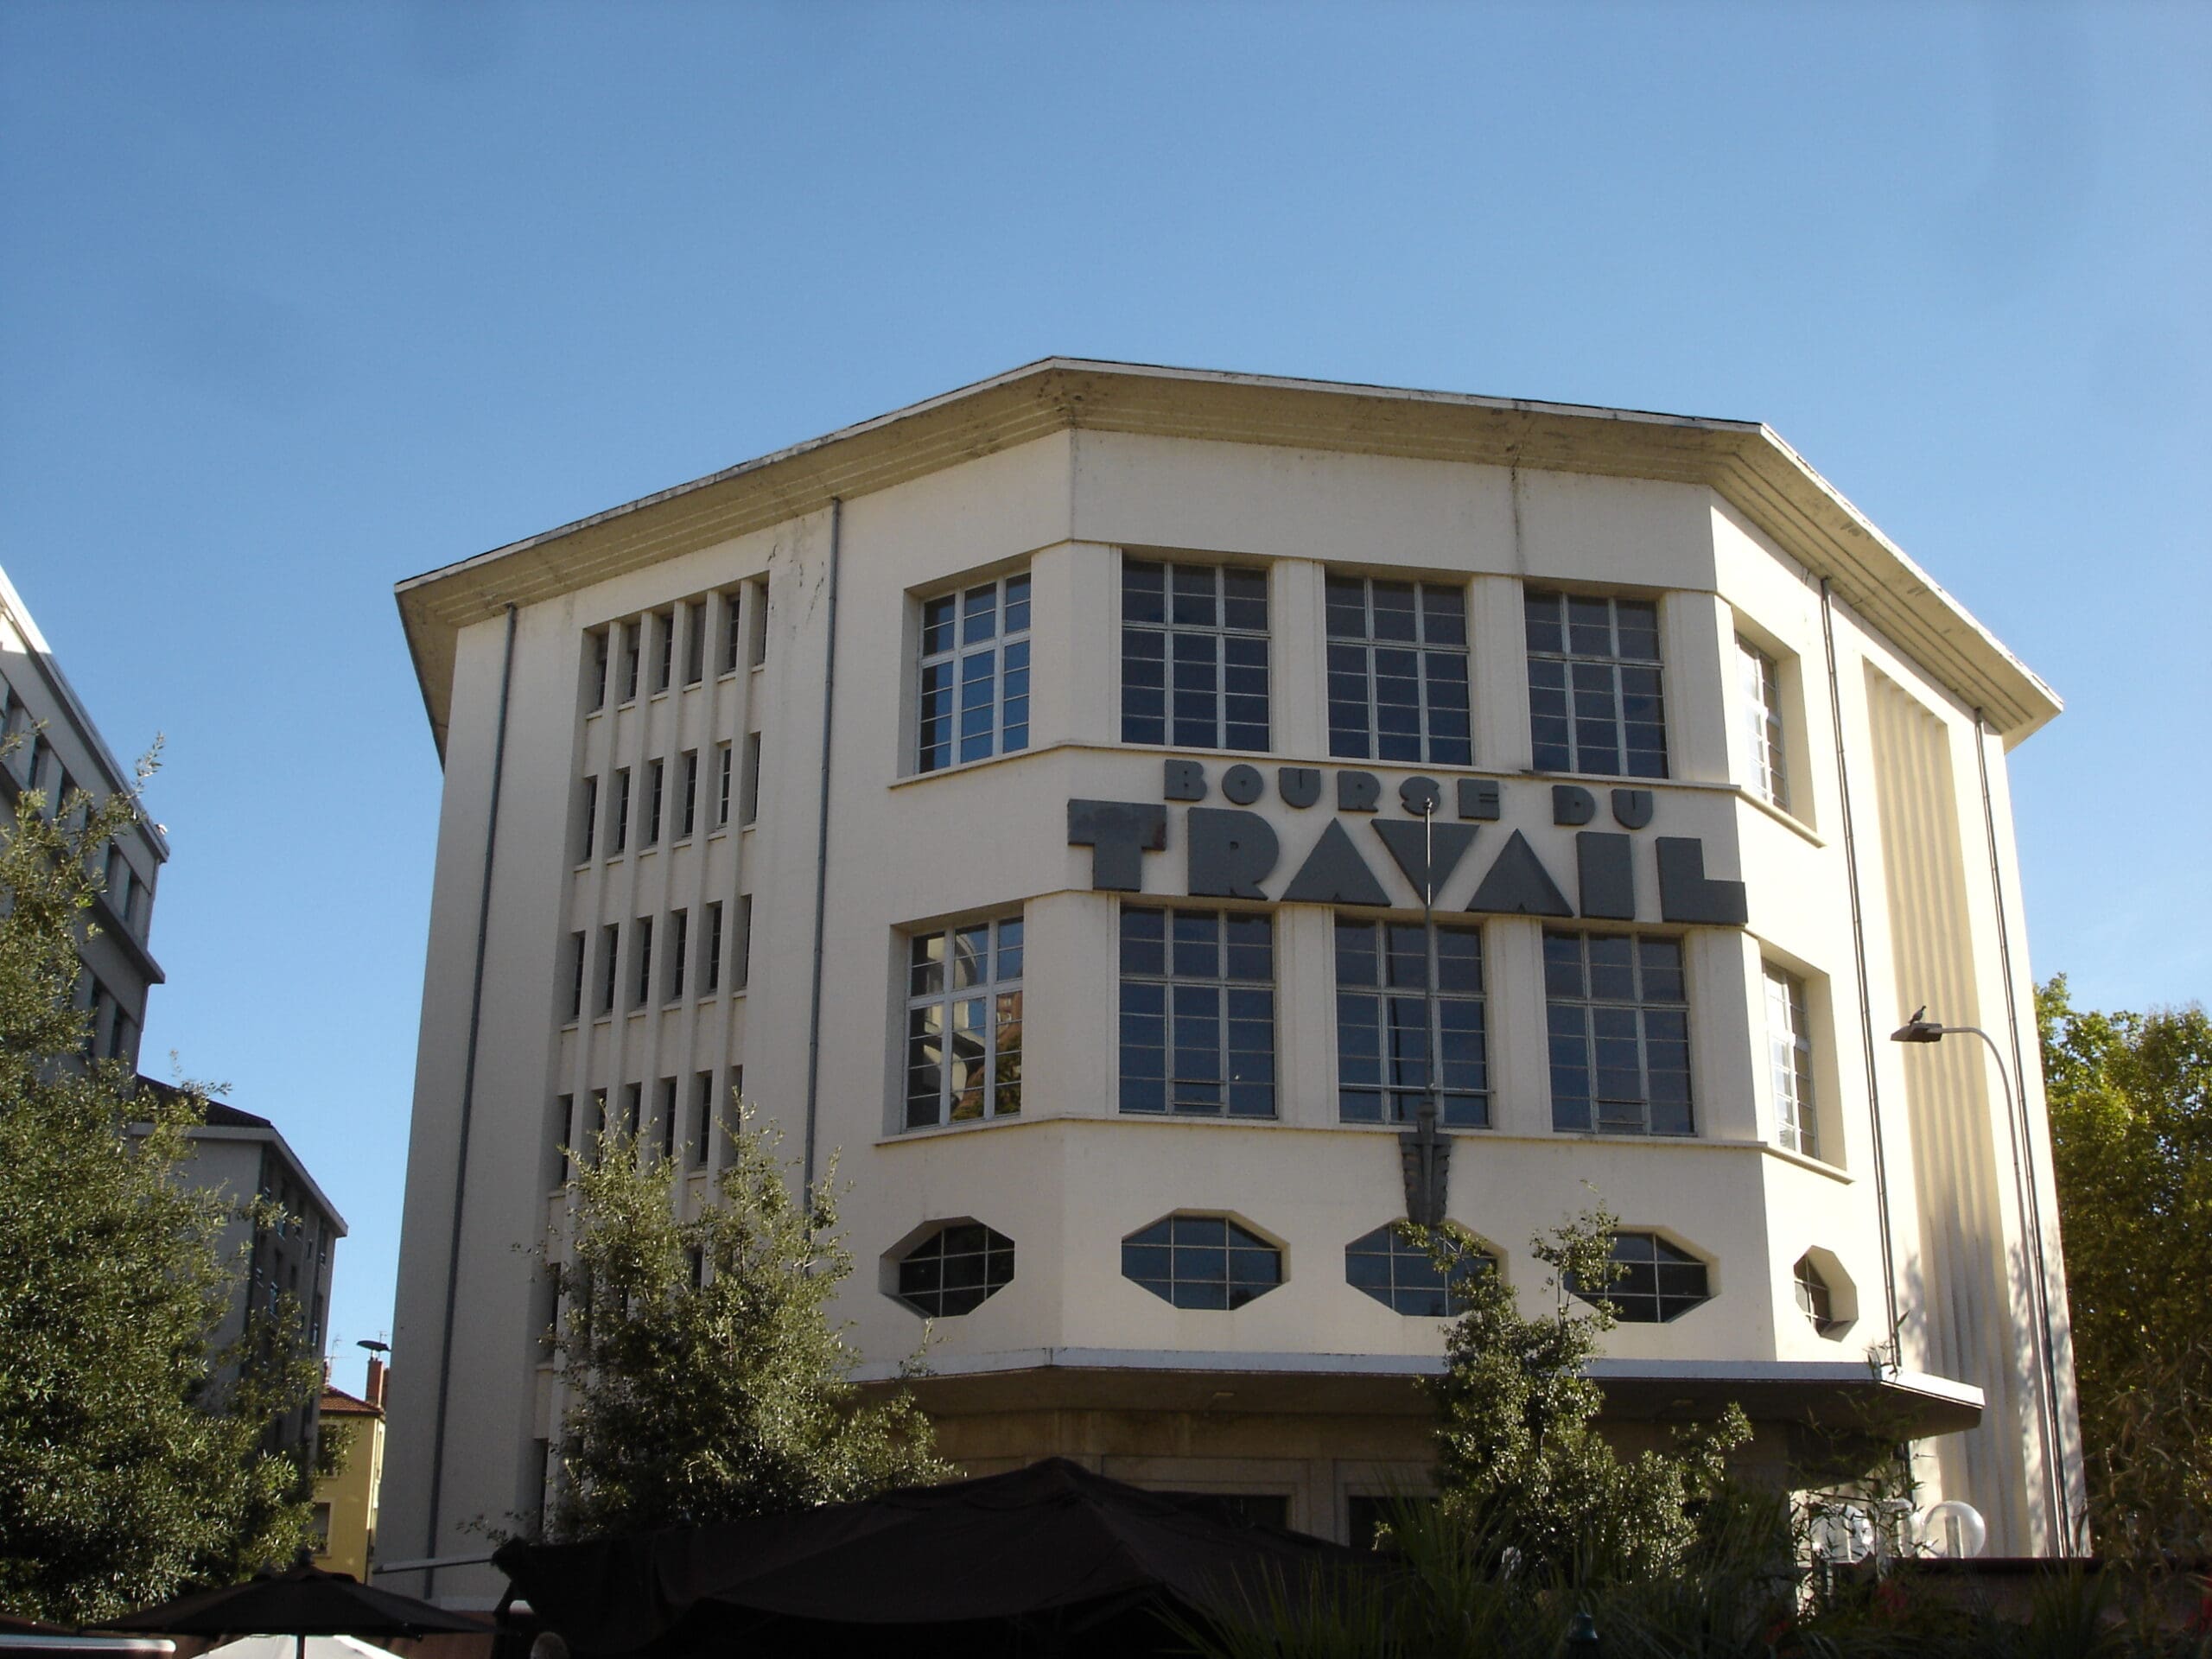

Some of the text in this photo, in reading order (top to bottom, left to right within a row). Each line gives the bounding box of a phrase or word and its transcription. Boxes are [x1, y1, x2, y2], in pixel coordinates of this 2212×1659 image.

[1164, 759, 1653, 830] BOURSE DU
[1067, 798, 1748, 925] TRAVAIL
